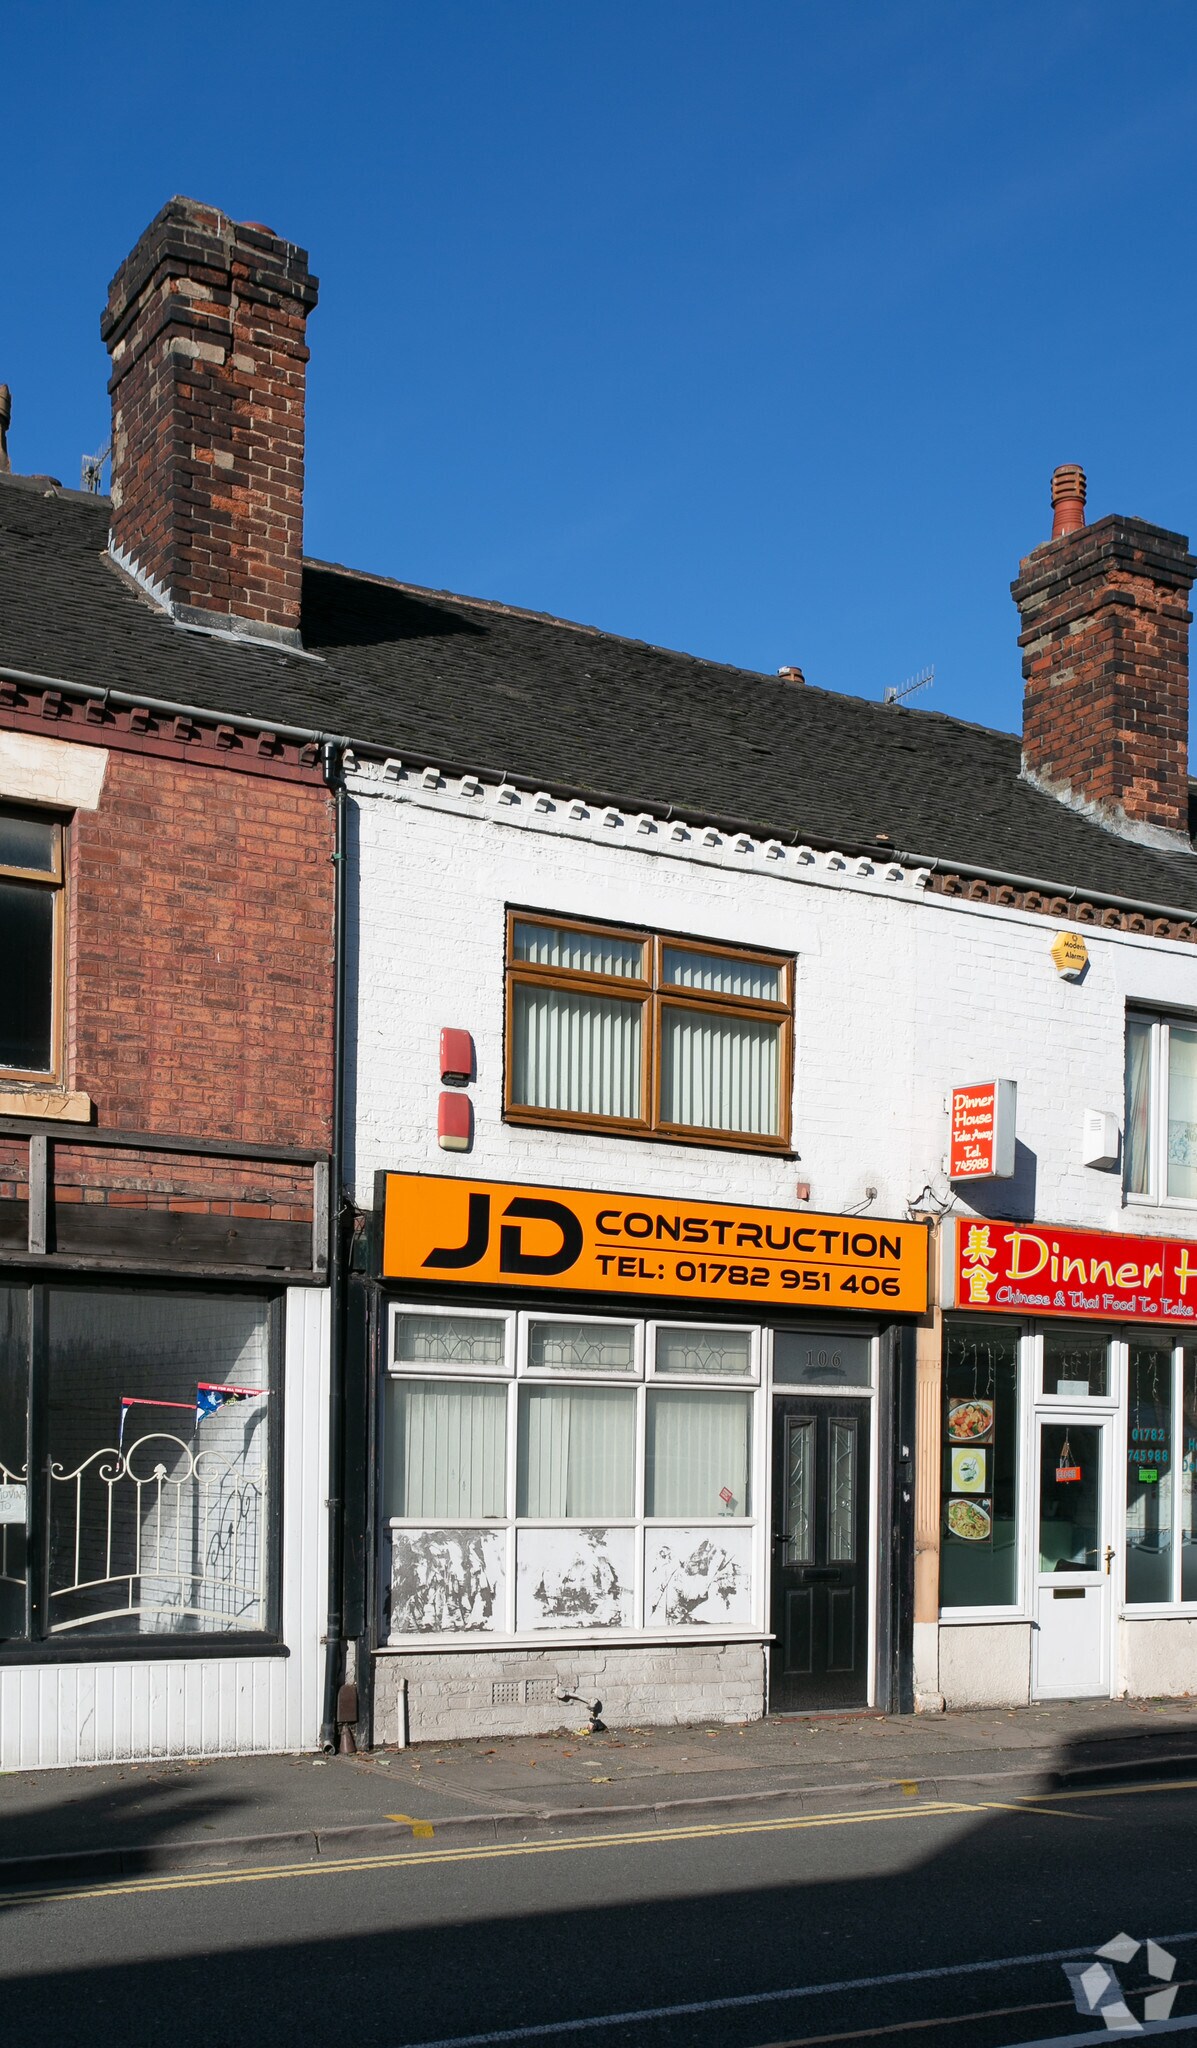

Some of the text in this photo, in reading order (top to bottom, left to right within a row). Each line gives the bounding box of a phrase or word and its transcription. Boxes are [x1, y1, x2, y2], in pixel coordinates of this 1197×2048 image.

[1063, 941, 1086, 951] Modern
[1065, 951, 1085, 962] Alarms
[954, 1094, 994, 1111] Dinner
[954, 1111, 993, 1128] House
[953, 1129, 993, 1142] Take Away
[955, 1158, 989, 1172] 745988
[420, 1192, 584, 1276] JD
[595, 1210, 902, 1261] CONSTRUCTION
[961, 1225, 999, 1304] 美食
[1003, 1230, 1163, 1289] Dinner
[595, 1255, 901, 1298] TEL: 01782 951 406
[995, 1286, 1194, 1316] Chinese & Thai Food To Take
[805, 1350, 842, 1368] 106
[1131, 1428, 1165, 1441] 01782
[1128, 1449, 1169, 1463] 745988
